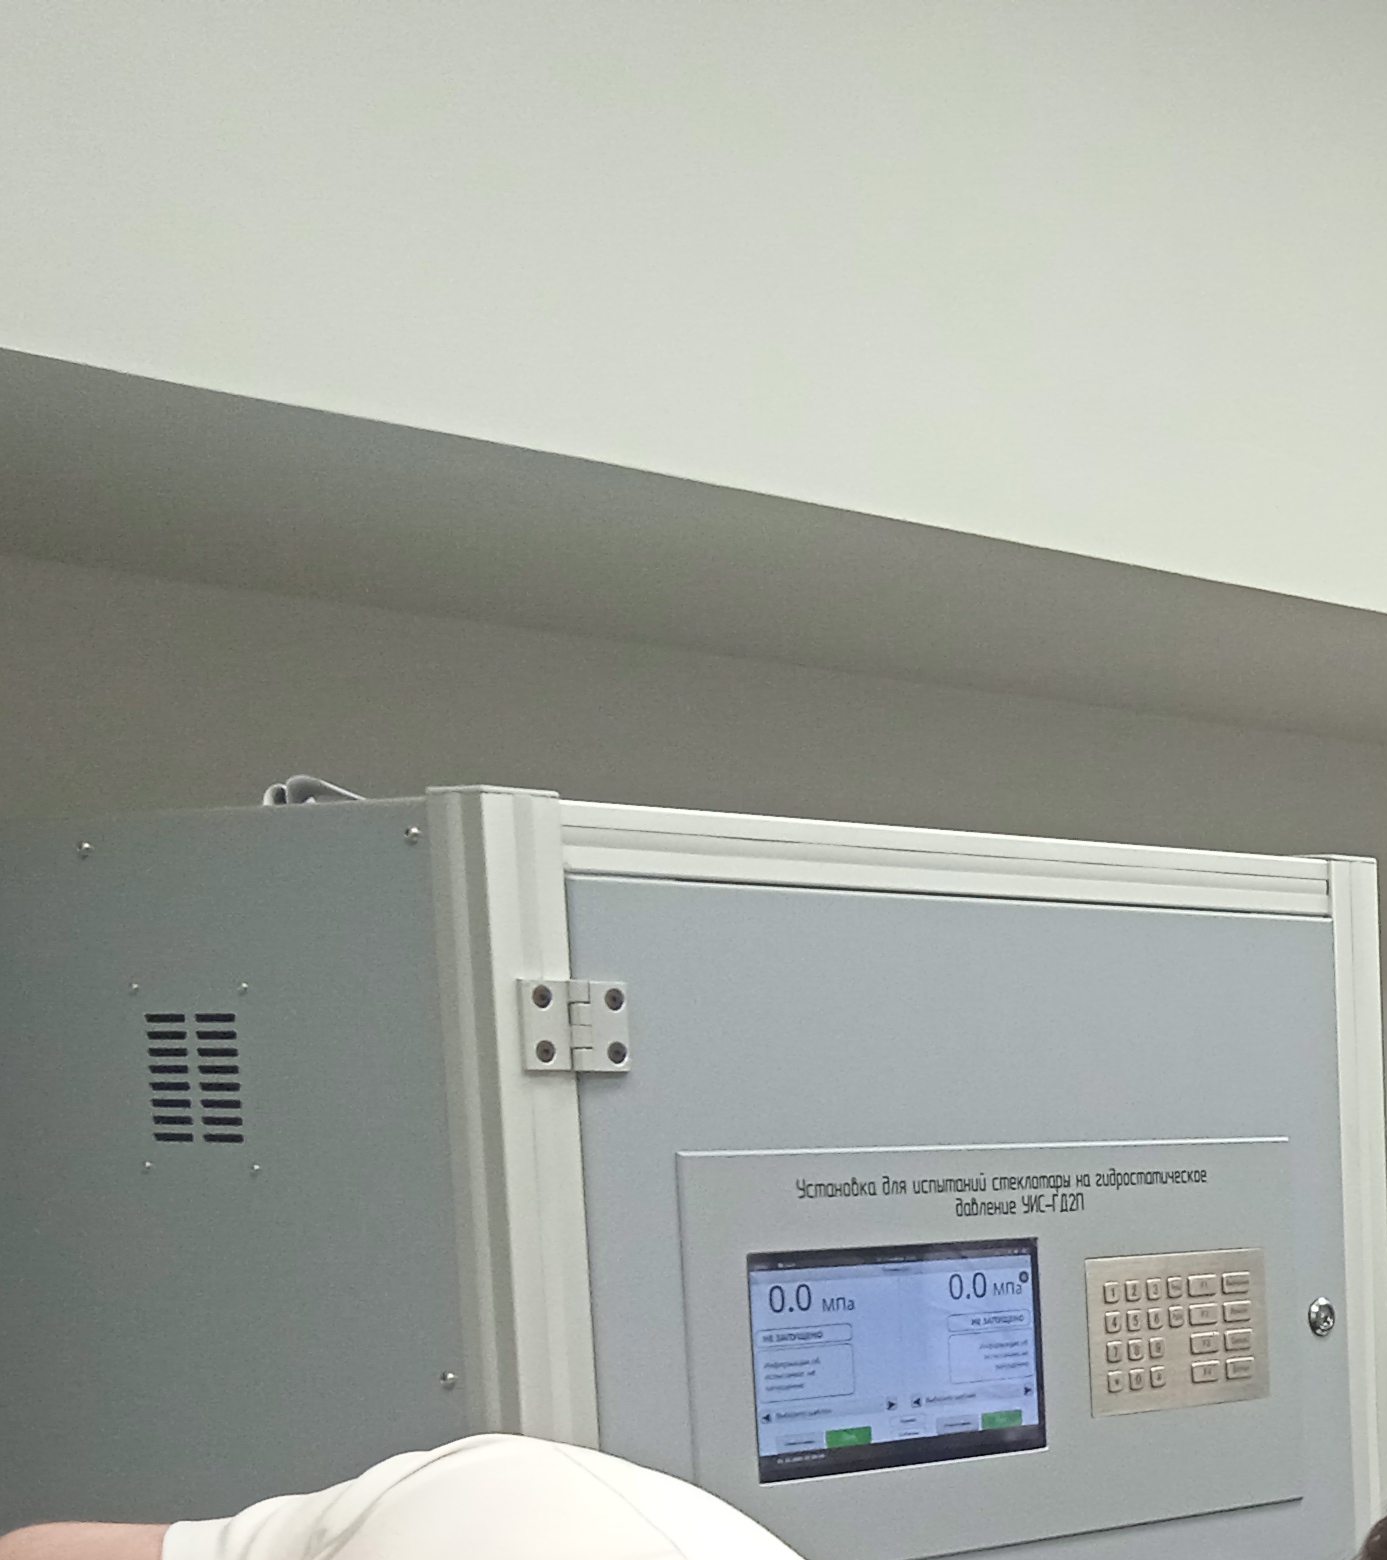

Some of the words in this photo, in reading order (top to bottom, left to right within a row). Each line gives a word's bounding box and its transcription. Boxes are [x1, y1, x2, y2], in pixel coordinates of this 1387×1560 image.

[796, 1175, 877, 1199] Установка
[881, 1175, 907, 1195] для
[912, 1172, 987, 1195] испытаний
[992, 1172, 1071, 1193] стеклотары
[1075, 1173, 1091, 1188] на
[1095, 1167, 1208, 1190] гидростатическое
[955, 1197, 1017, 1217] давление
[769, 1283, 812, 1314] 0.0
[822, 1297, 856, 1313] МПа
[949, 1271, 987, 1300] 0.0
[993, 1280, 1023, 1297] МПа
